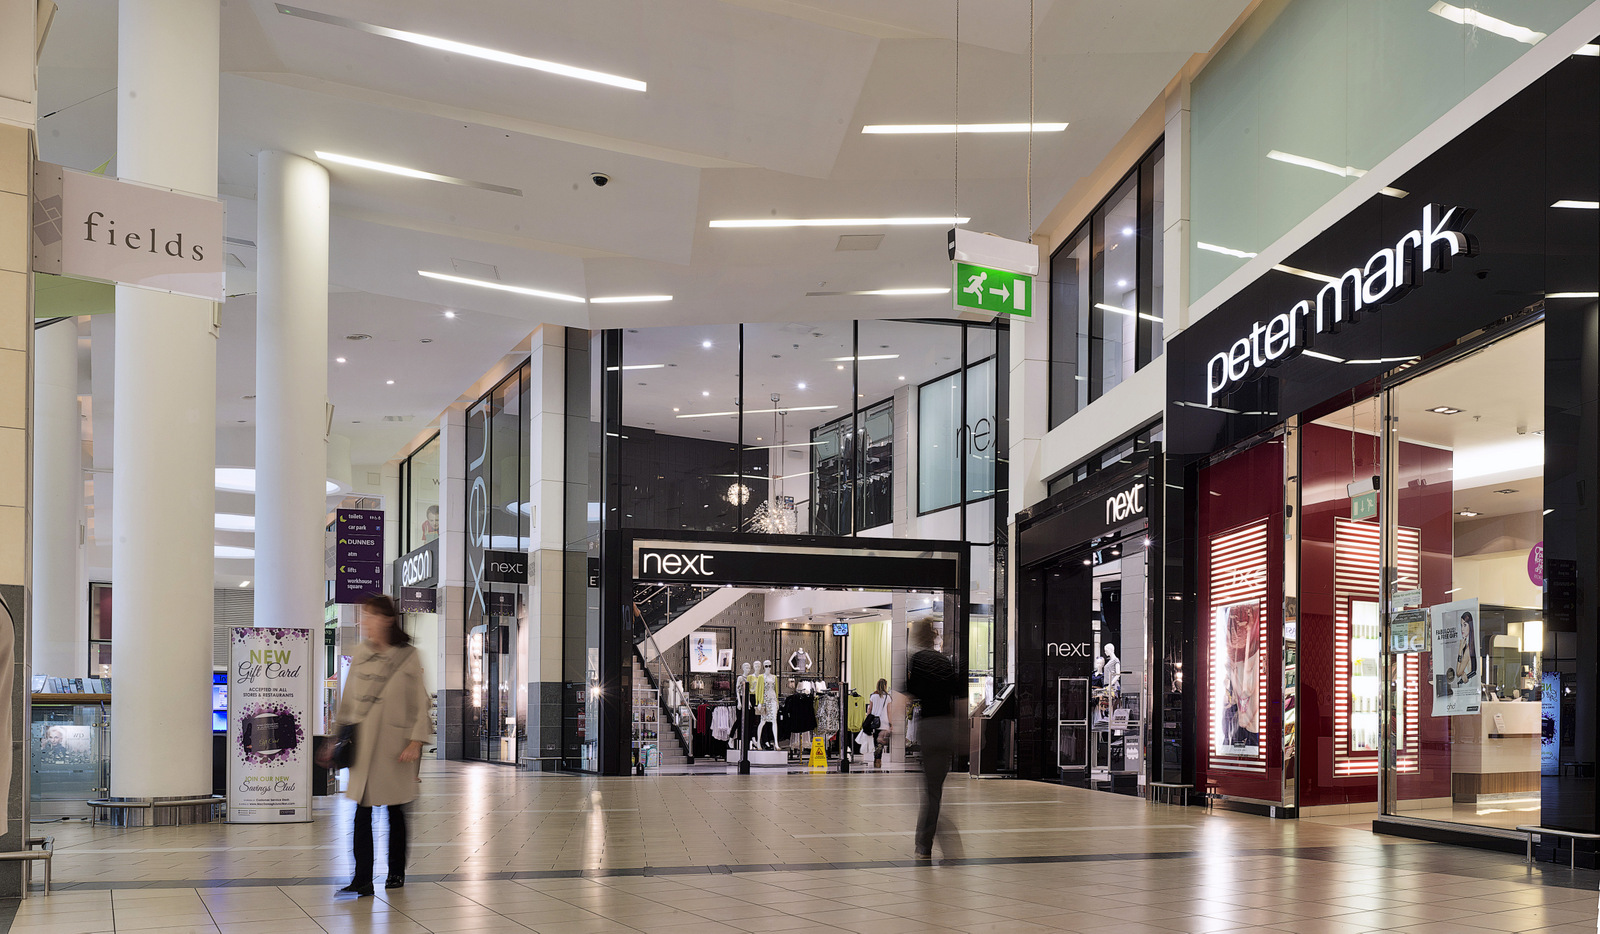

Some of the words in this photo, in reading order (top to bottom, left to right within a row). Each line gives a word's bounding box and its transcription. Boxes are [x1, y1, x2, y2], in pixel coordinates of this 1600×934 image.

[83, 211, 204, 261] fields
[1207, 299, 1310, 408] peter
[1316, 202, 1464, 334] mark
[1106, 483, 1144, 525] next
[402, 550, 431, 587] eason
[490, 561, 524, 574] next
[643, 552, 714, 576] next
[250, 649, 291, 664] NEW
[1047, 642, 1090, 657] next
[237, 660, 262, 684] Gift
[265, 662, 301, 679] Card
[239, 780, 271, 795] Savings
[274, 780, 296, 793] Club
